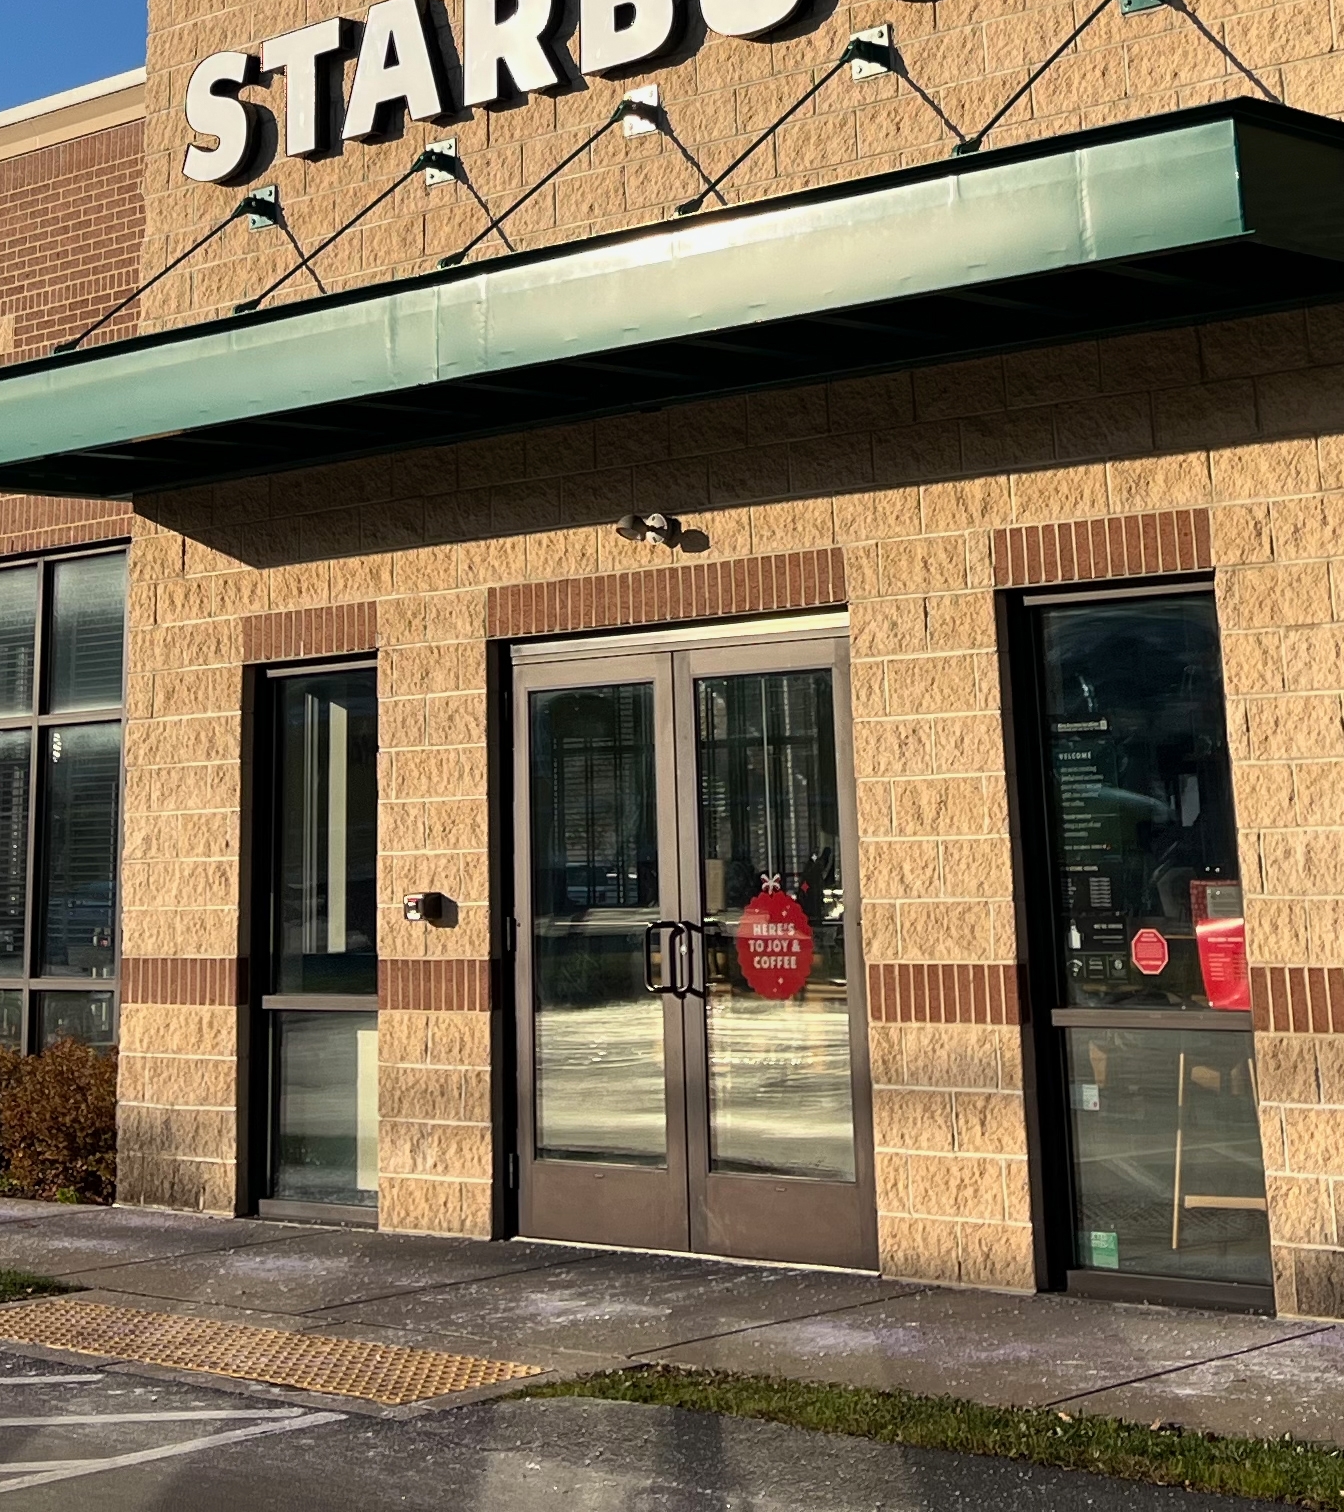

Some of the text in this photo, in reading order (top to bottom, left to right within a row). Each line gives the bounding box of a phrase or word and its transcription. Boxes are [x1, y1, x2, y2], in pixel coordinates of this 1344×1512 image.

[1058, 751, 1091, 760] WELCOME
[753, 923, 794, 936] HERE'S
[748, 940, 800, 952] TO JOY &
[754, 956, 797, 969] COFFEE
